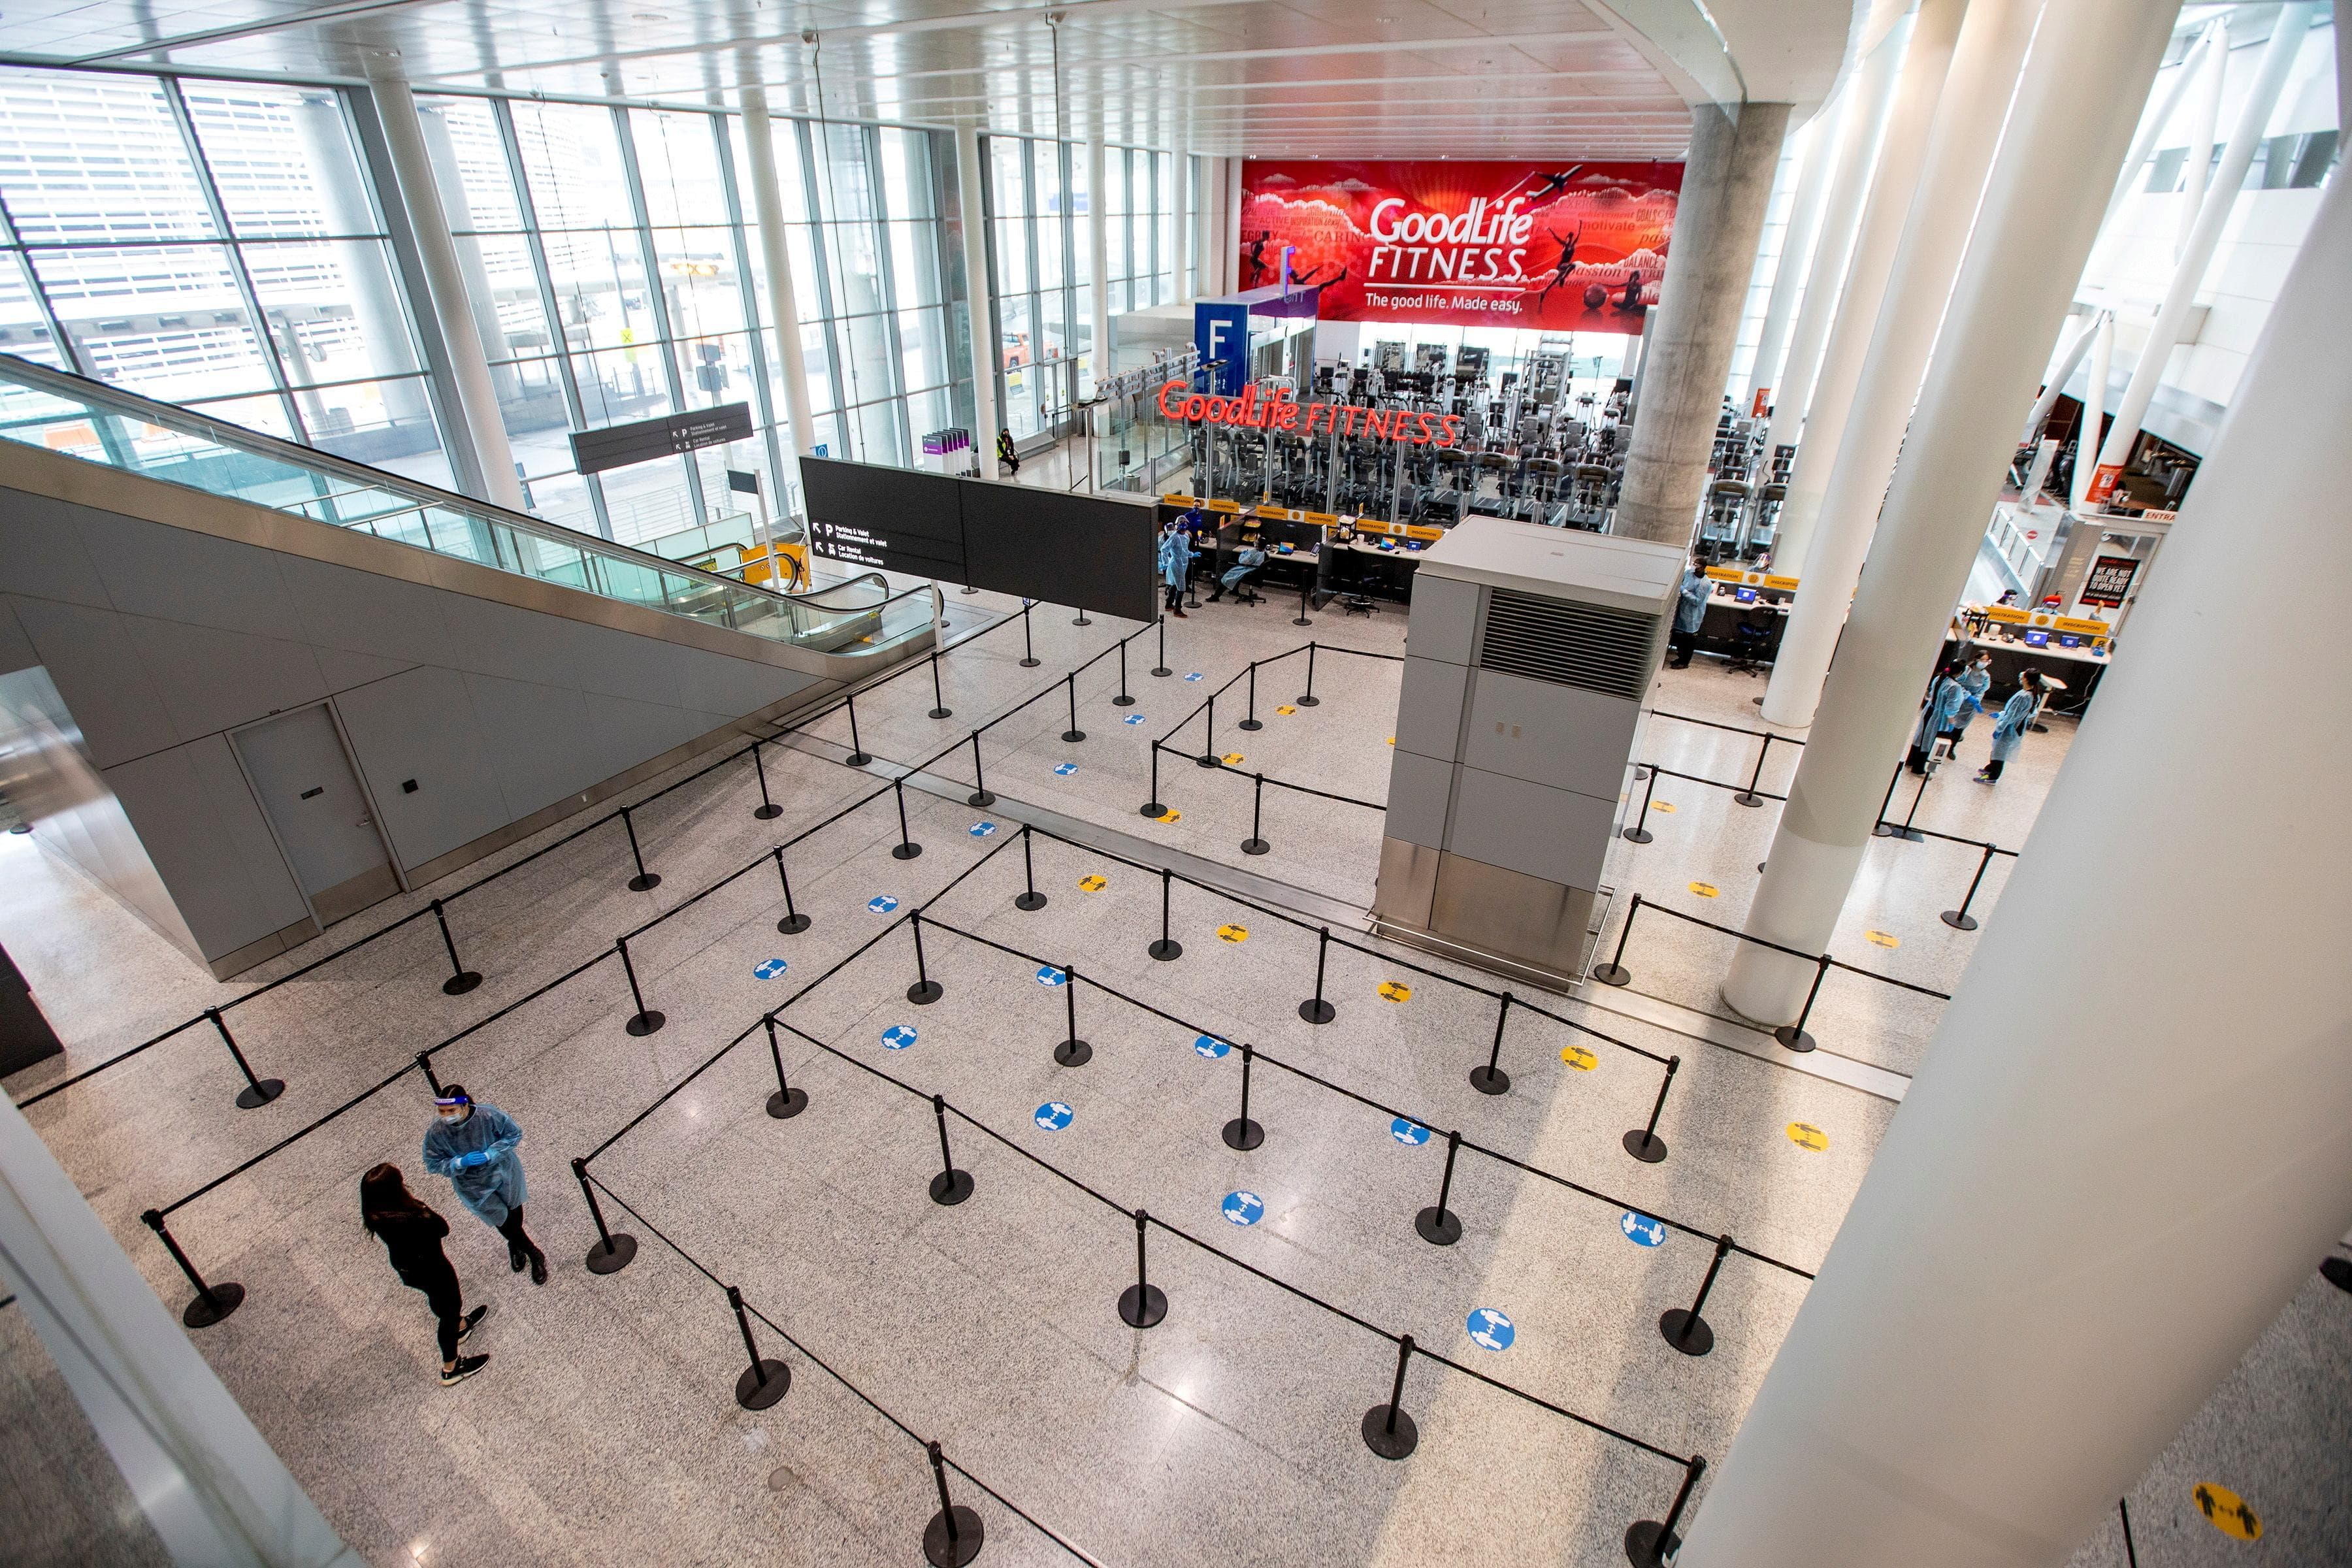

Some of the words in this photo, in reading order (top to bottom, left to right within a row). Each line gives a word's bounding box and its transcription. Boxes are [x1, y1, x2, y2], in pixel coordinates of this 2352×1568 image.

[1259, 216, 1289, 224] ACTIVE
[1290, 216, 1323, 226] INSPIRATION
[1369, 197, 1533, 245] GoodLife
[1636, 208, 1657, 221] GOALS
[1368, 246, 1527, 282] FITNESS
[1624, 255, 1658, 269] BALANCE
[1365, 293, 1388, 307] The
[1391, 293, 1422, 310] good
[1426, 294, 1448, 309] life.
[1451, 296, 1488, 310] Made
[1490, 300, 1523, 315] easy.
[1209, 320, 1232, 359] F
[1158, 380, 1299, 430] GoodLife
[1306, 402, 1461, 447] FITNESS
[835, 525, 853, 535] Parking
[857, 529, 870, 537] Valet
[836, 532, 869, 544] Stationnement
[875, 539, 887, 547] valet
[846, 546, 861, 555] Rental
[838, 551, 858, 561] Location
[864, 556, 883, 566] voitures
